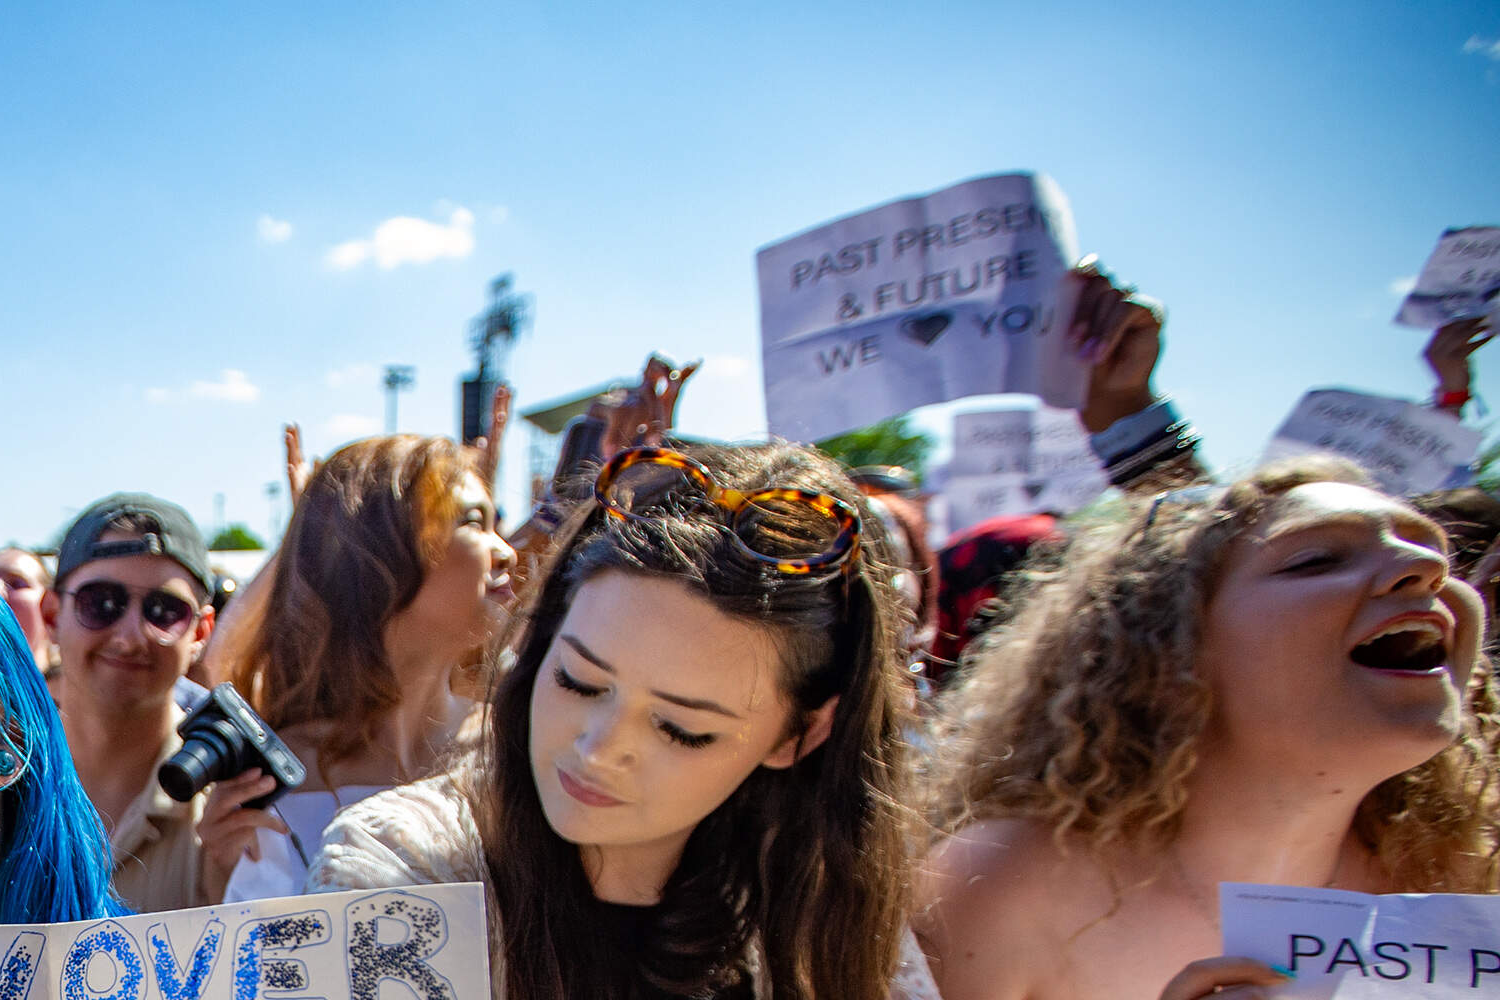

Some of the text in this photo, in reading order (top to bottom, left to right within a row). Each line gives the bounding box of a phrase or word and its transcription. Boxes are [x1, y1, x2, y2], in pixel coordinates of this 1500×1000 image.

[789, 235, 885, 291] PAST
[836, 249, 1040, 321] & FUTURE
[815, 302, 1056, 377] WE YOU
[1288, 933, 1448, 985] PAST
